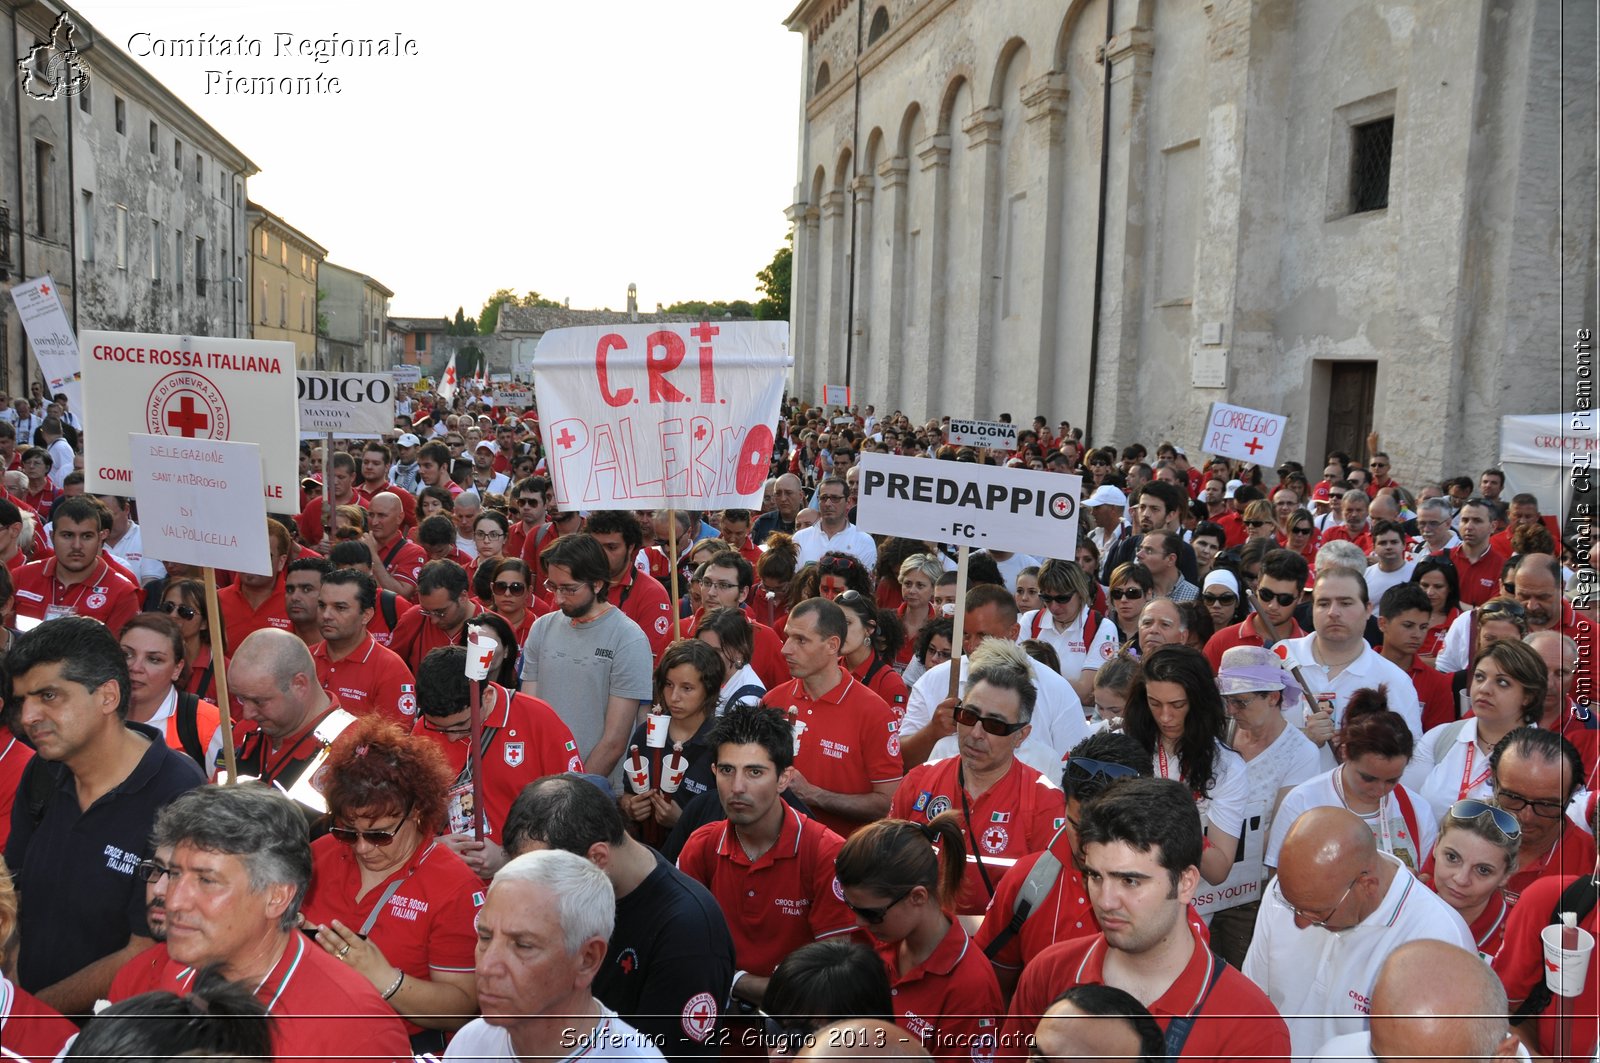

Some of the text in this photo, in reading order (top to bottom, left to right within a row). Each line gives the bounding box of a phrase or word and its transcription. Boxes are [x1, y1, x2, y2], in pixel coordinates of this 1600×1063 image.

[93, 345, 145, 363] CROCE
[150, 349, 202, 368] ROSSA
[208, 353, 282, 374] ITALIANA
[160, 384, 170, 396] DI
[170, 377, 208, 394] GINEVRA
[208, 392, 218, 404] 22
[304, 408, 350, 418] MANTOVA
[314, 420, 342, 428] (ITALY)
[1213, 408, 1278, 436] CORREGGIO
[950, 424, 1016, 438] BOLOGNA
[1210, 432, 1232, 452] RE
[1534, 435, 1580, 450] CROCE
[150, 446, 224, 464] DELEGAZIONE
[550, 416, 775, 504] PALERMO
[99, 467, 134, 482] COMI
[864, 470, 1075, 520] PREDAPPIO
[180, 506, 193, 517] DI
[161, 523, 238, 548] VALPOLICELLA
[952, 522, 975, 538] FC
[595, 648, 614, 660] DIESEL
[104, 844, 123, 859] CROCE
[106, 857, 134, 875] ITALIANA
[1192, 881, 1257, 907] OSS YOUTH
[408, 898, 429, 912] ROSSA
[775, 898, 794, 906] CROCE
[391, 906, 418, 921] ITALIANA
